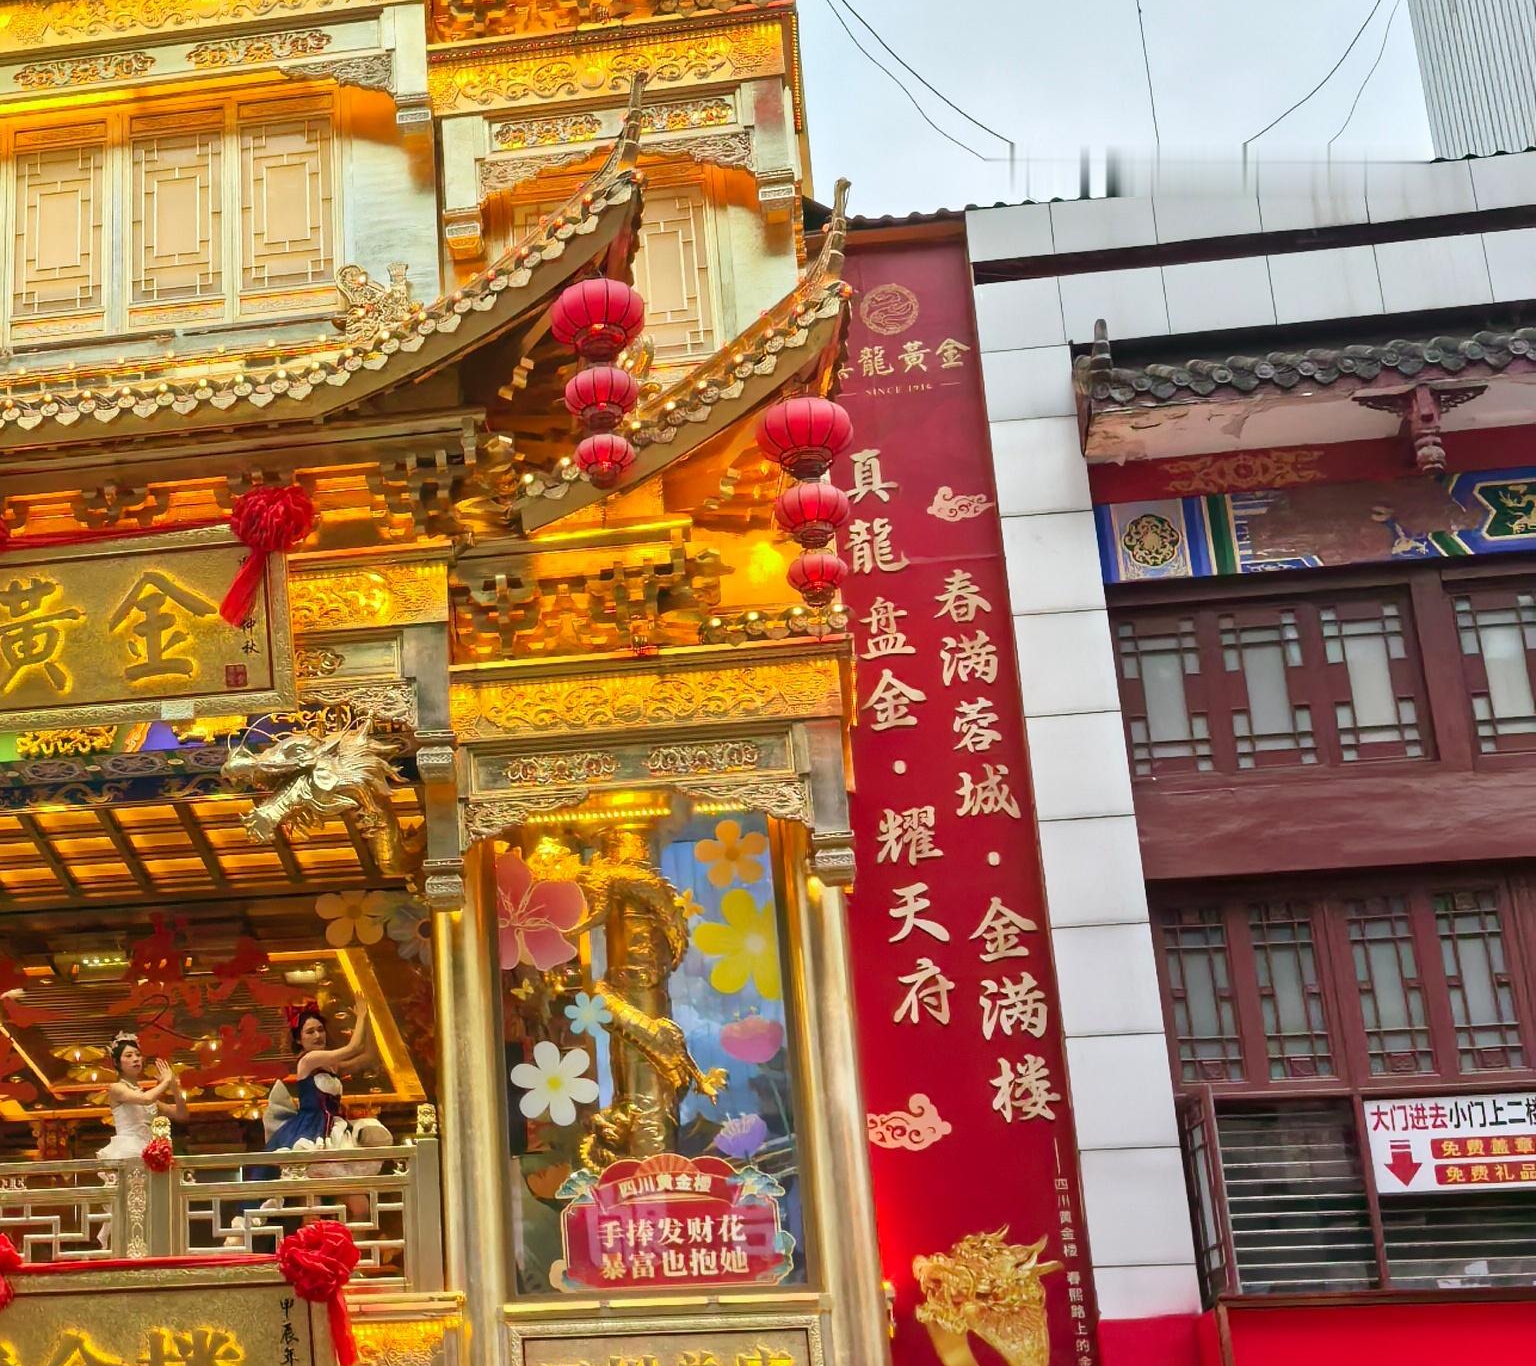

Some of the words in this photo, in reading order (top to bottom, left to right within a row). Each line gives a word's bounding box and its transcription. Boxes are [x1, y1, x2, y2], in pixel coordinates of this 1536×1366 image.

[598, 1214, 748, 1248] 手捧发财花
